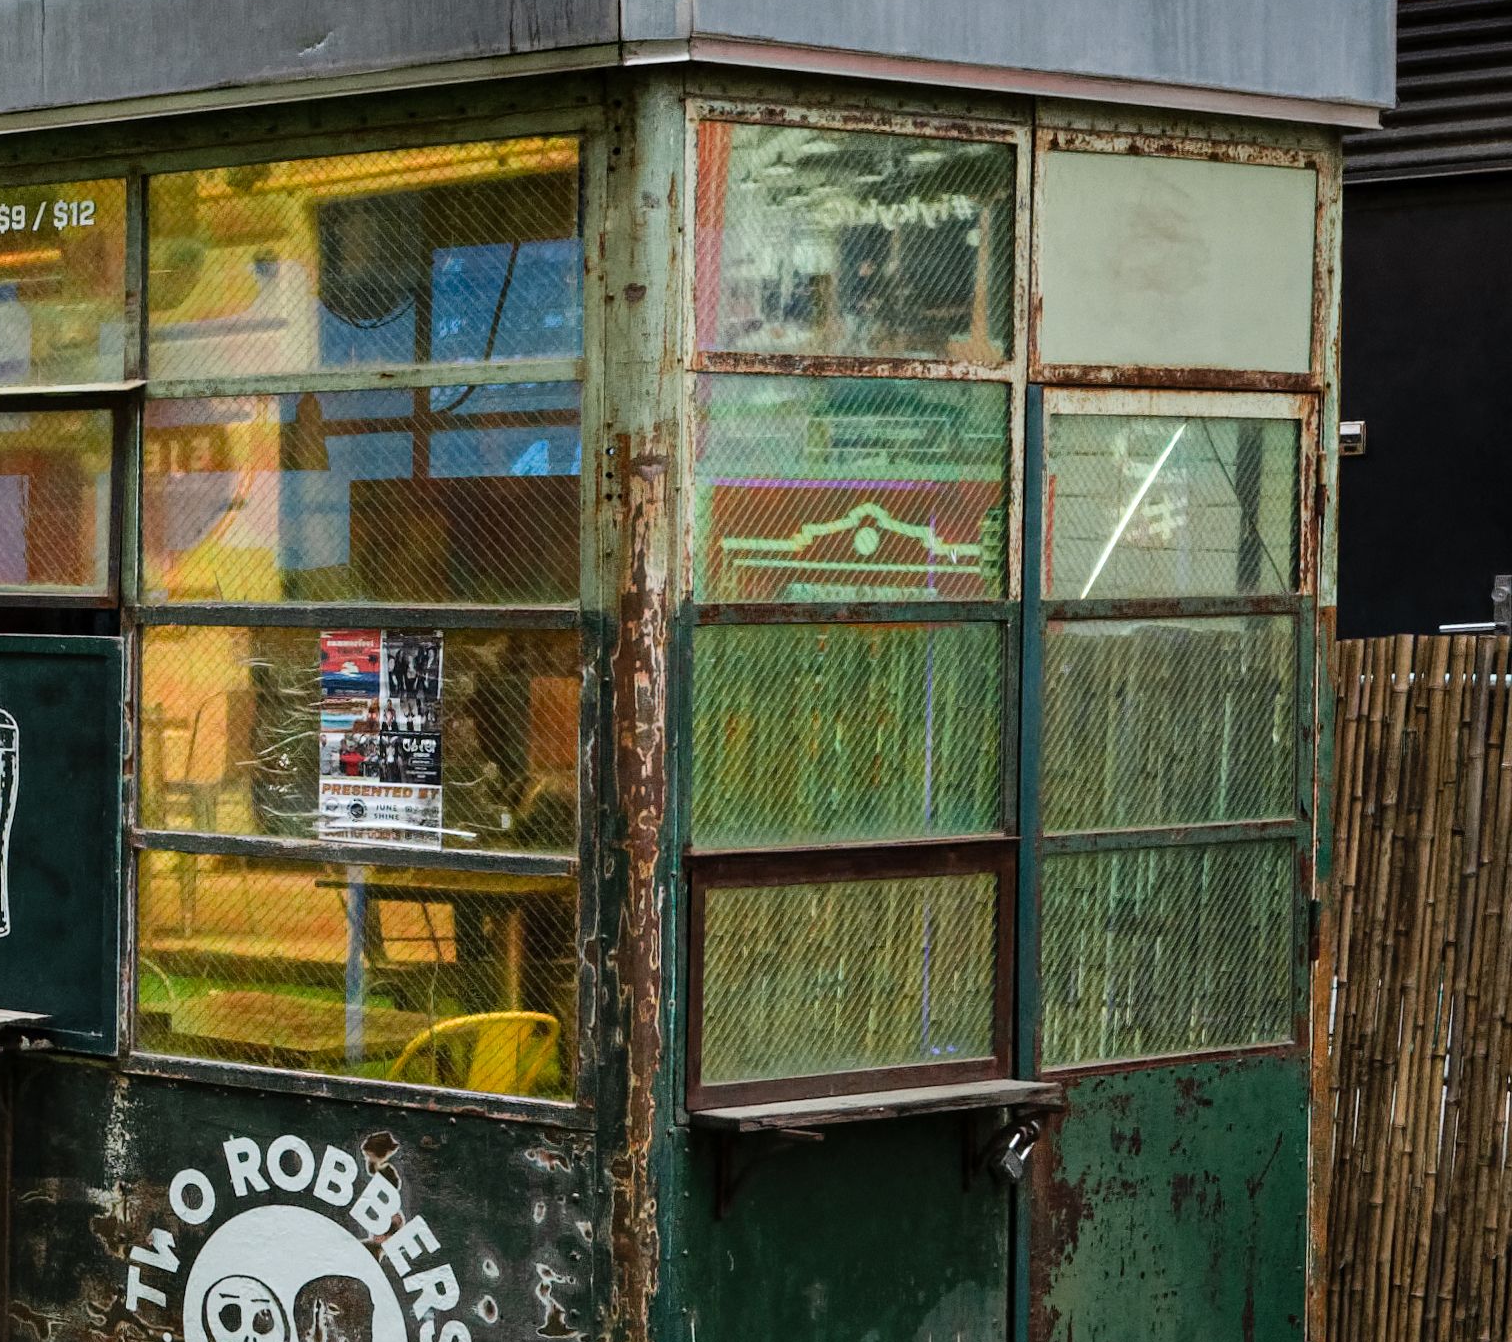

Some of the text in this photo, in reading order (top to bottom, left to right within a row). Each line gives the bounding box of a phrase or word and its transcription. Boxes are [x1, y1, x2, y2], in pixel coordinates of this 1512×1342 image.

[53, 200, 95, 231] $12
[321, 783, 413, 799] PRESENTED
[376, 804, 398, 812] JUNE
[125, 1168, 216, 1312] TWO
